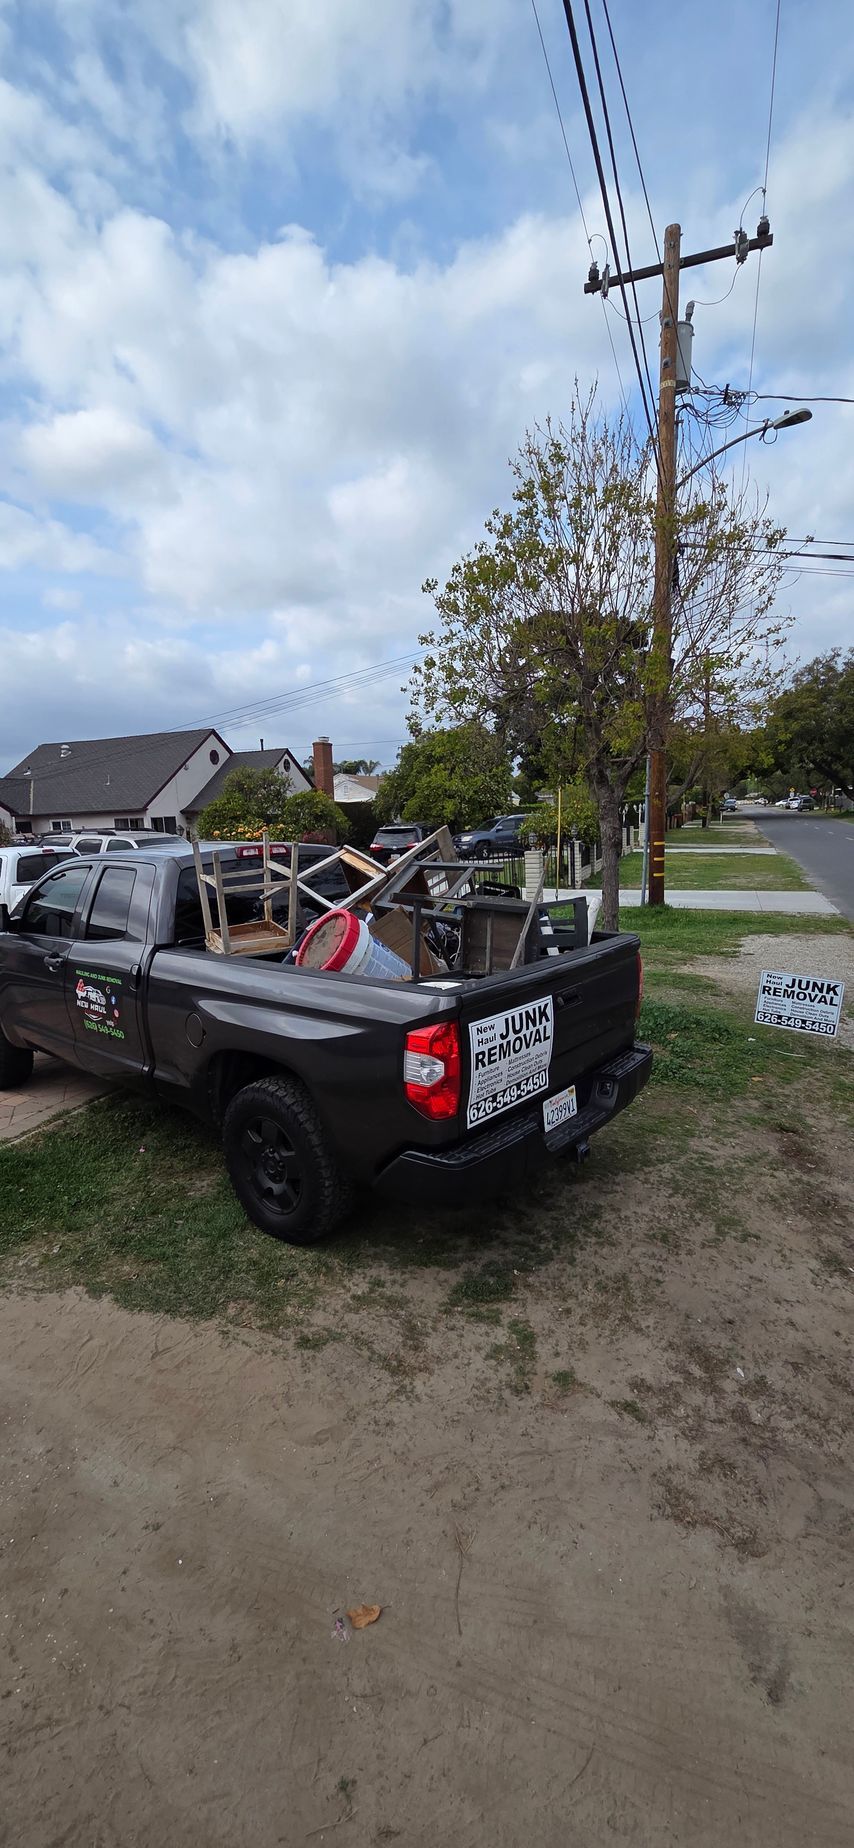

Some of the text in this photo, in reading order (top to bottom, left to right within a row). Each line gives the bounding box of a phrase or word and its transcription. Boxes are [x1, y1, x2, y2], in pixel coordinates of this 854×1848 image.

[785, 978, 840, 996] JUNK
[762, 985, 838, 1007] REMOVAL
[77, 1000, 107, 1014] NEW HAUL
[791, 1004, 819, 1013] Construction
[477, 1024, 495, 1035] New
[500, 1003, 550, 1040] JUNK
[757, 1012, 834, 1034] 626-549-5450
[98, 1023, 125, 1039] 549-5450
[475, 1025, 550, 1071] REMOVAL
[478, 1033, 496, 1047] Haul
[507, 1069, 520, 1079] House
[521, 1063, 533, 1072] Clean
[508, 1056, 535, 1072] Construction
[478, 1066, 500, 1079] Furniture
[478, 1071, 503, 1086] Appliances
[477, 1078, 502, 1093] Electronics
[470, 1070, 546, 1120] 626-549-5450
